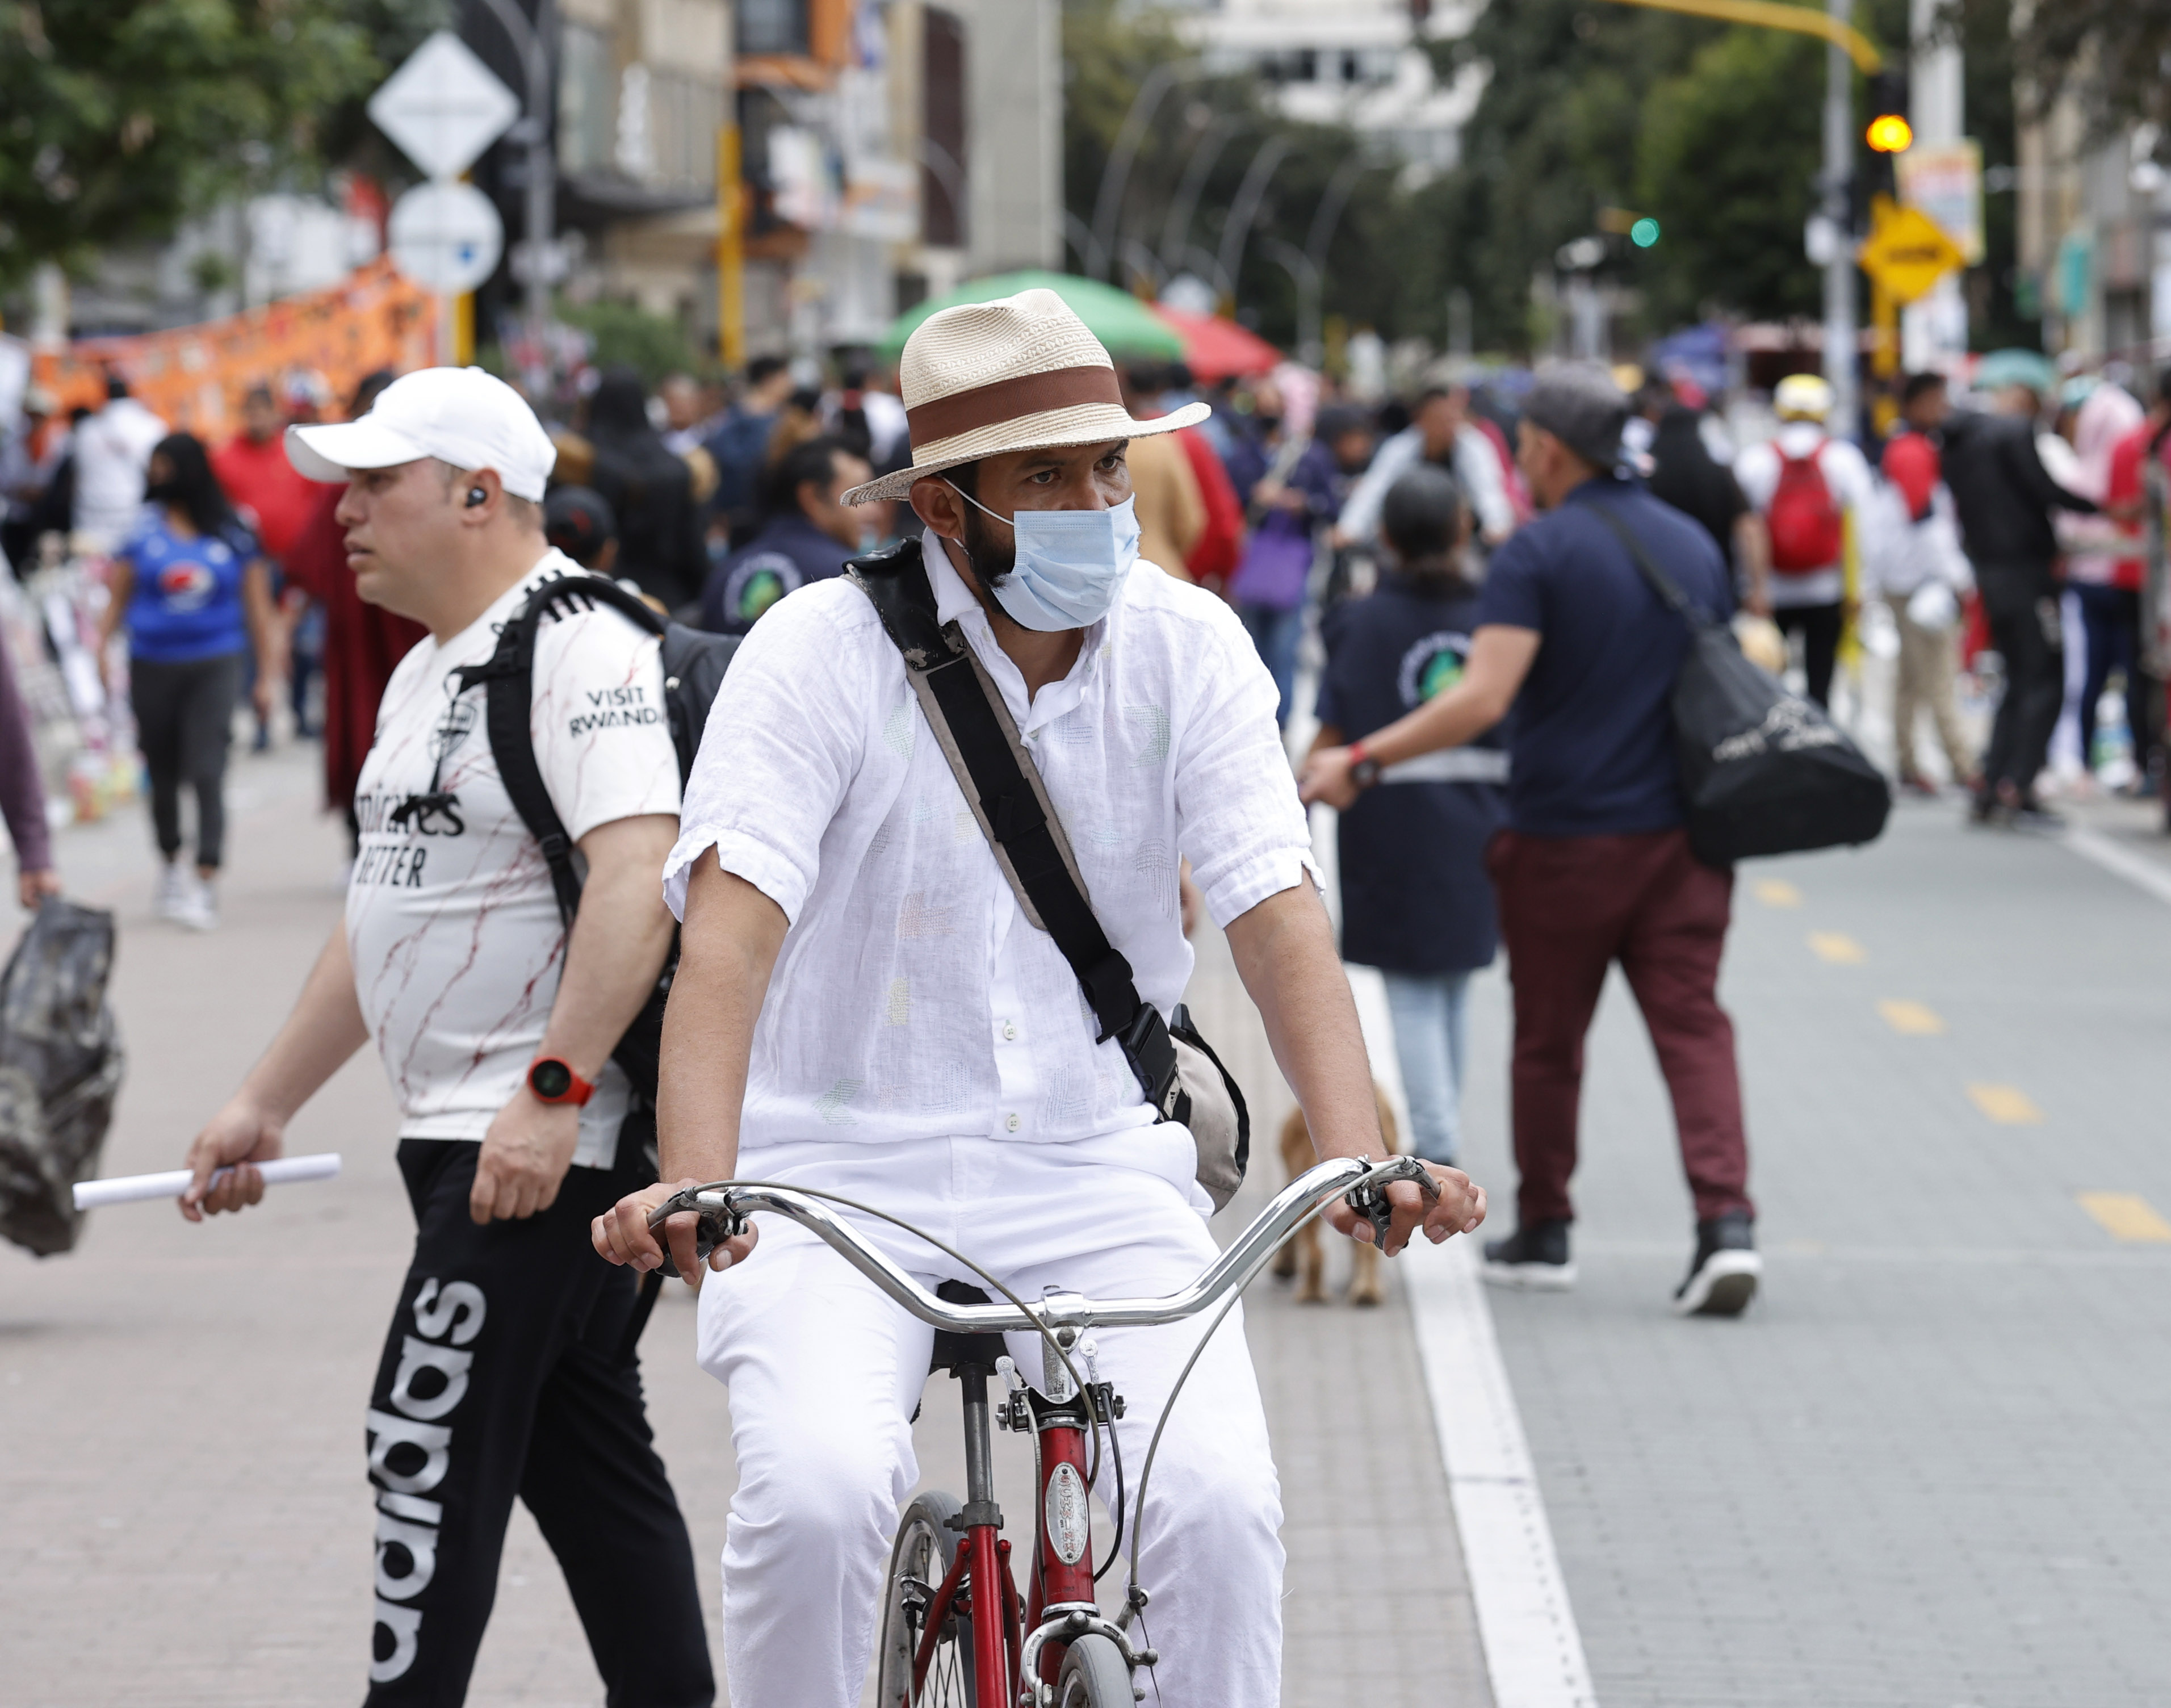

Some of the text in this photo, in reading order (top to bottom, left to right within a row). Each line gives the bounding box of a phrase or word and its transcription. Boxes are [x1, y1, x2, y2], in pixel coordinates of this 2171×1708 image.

[569, 708, 660, 738] RWAND
[586, 687, 643, 706] VISIT
[366, 1277, 487, 1683] adidas
[1059, 1475, 1076, 1552] SCHWINN
